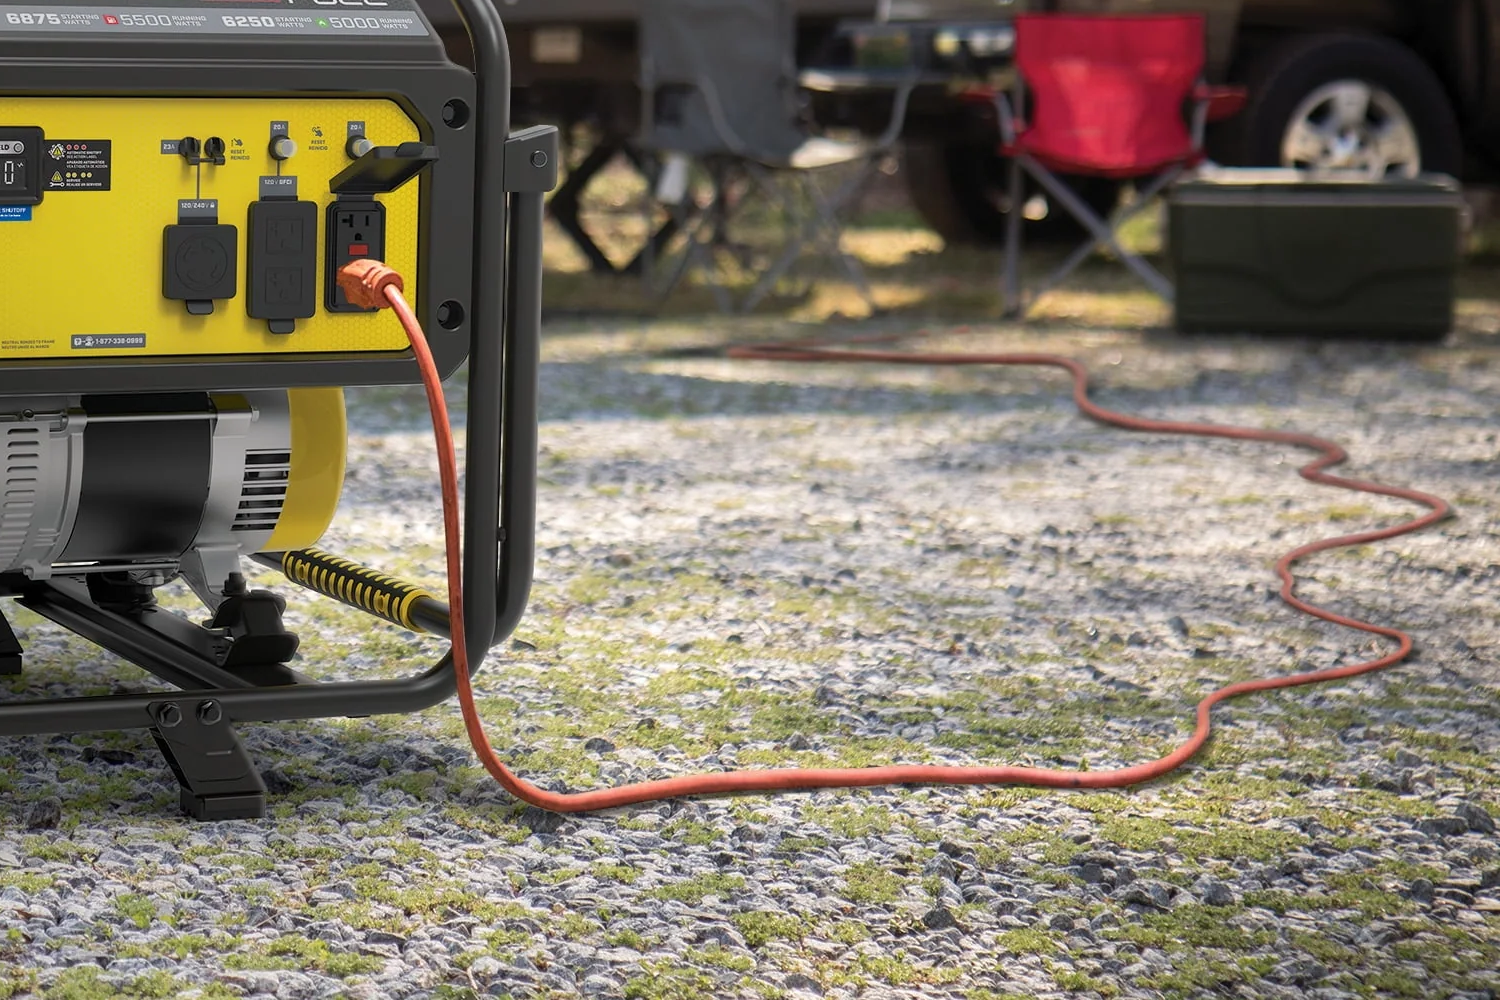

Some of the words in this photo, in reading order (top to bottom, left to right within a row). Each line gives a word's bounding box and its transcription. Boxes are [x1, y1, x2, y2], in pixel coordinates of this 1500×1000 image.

[5, 13, 61, 25] 6875
[60, 13, 100, 21] STARTING
[119, 14, 172, 26] 5500
[221, 15, 276, 28] 6250
[329, 17, 380, 29] 5000
